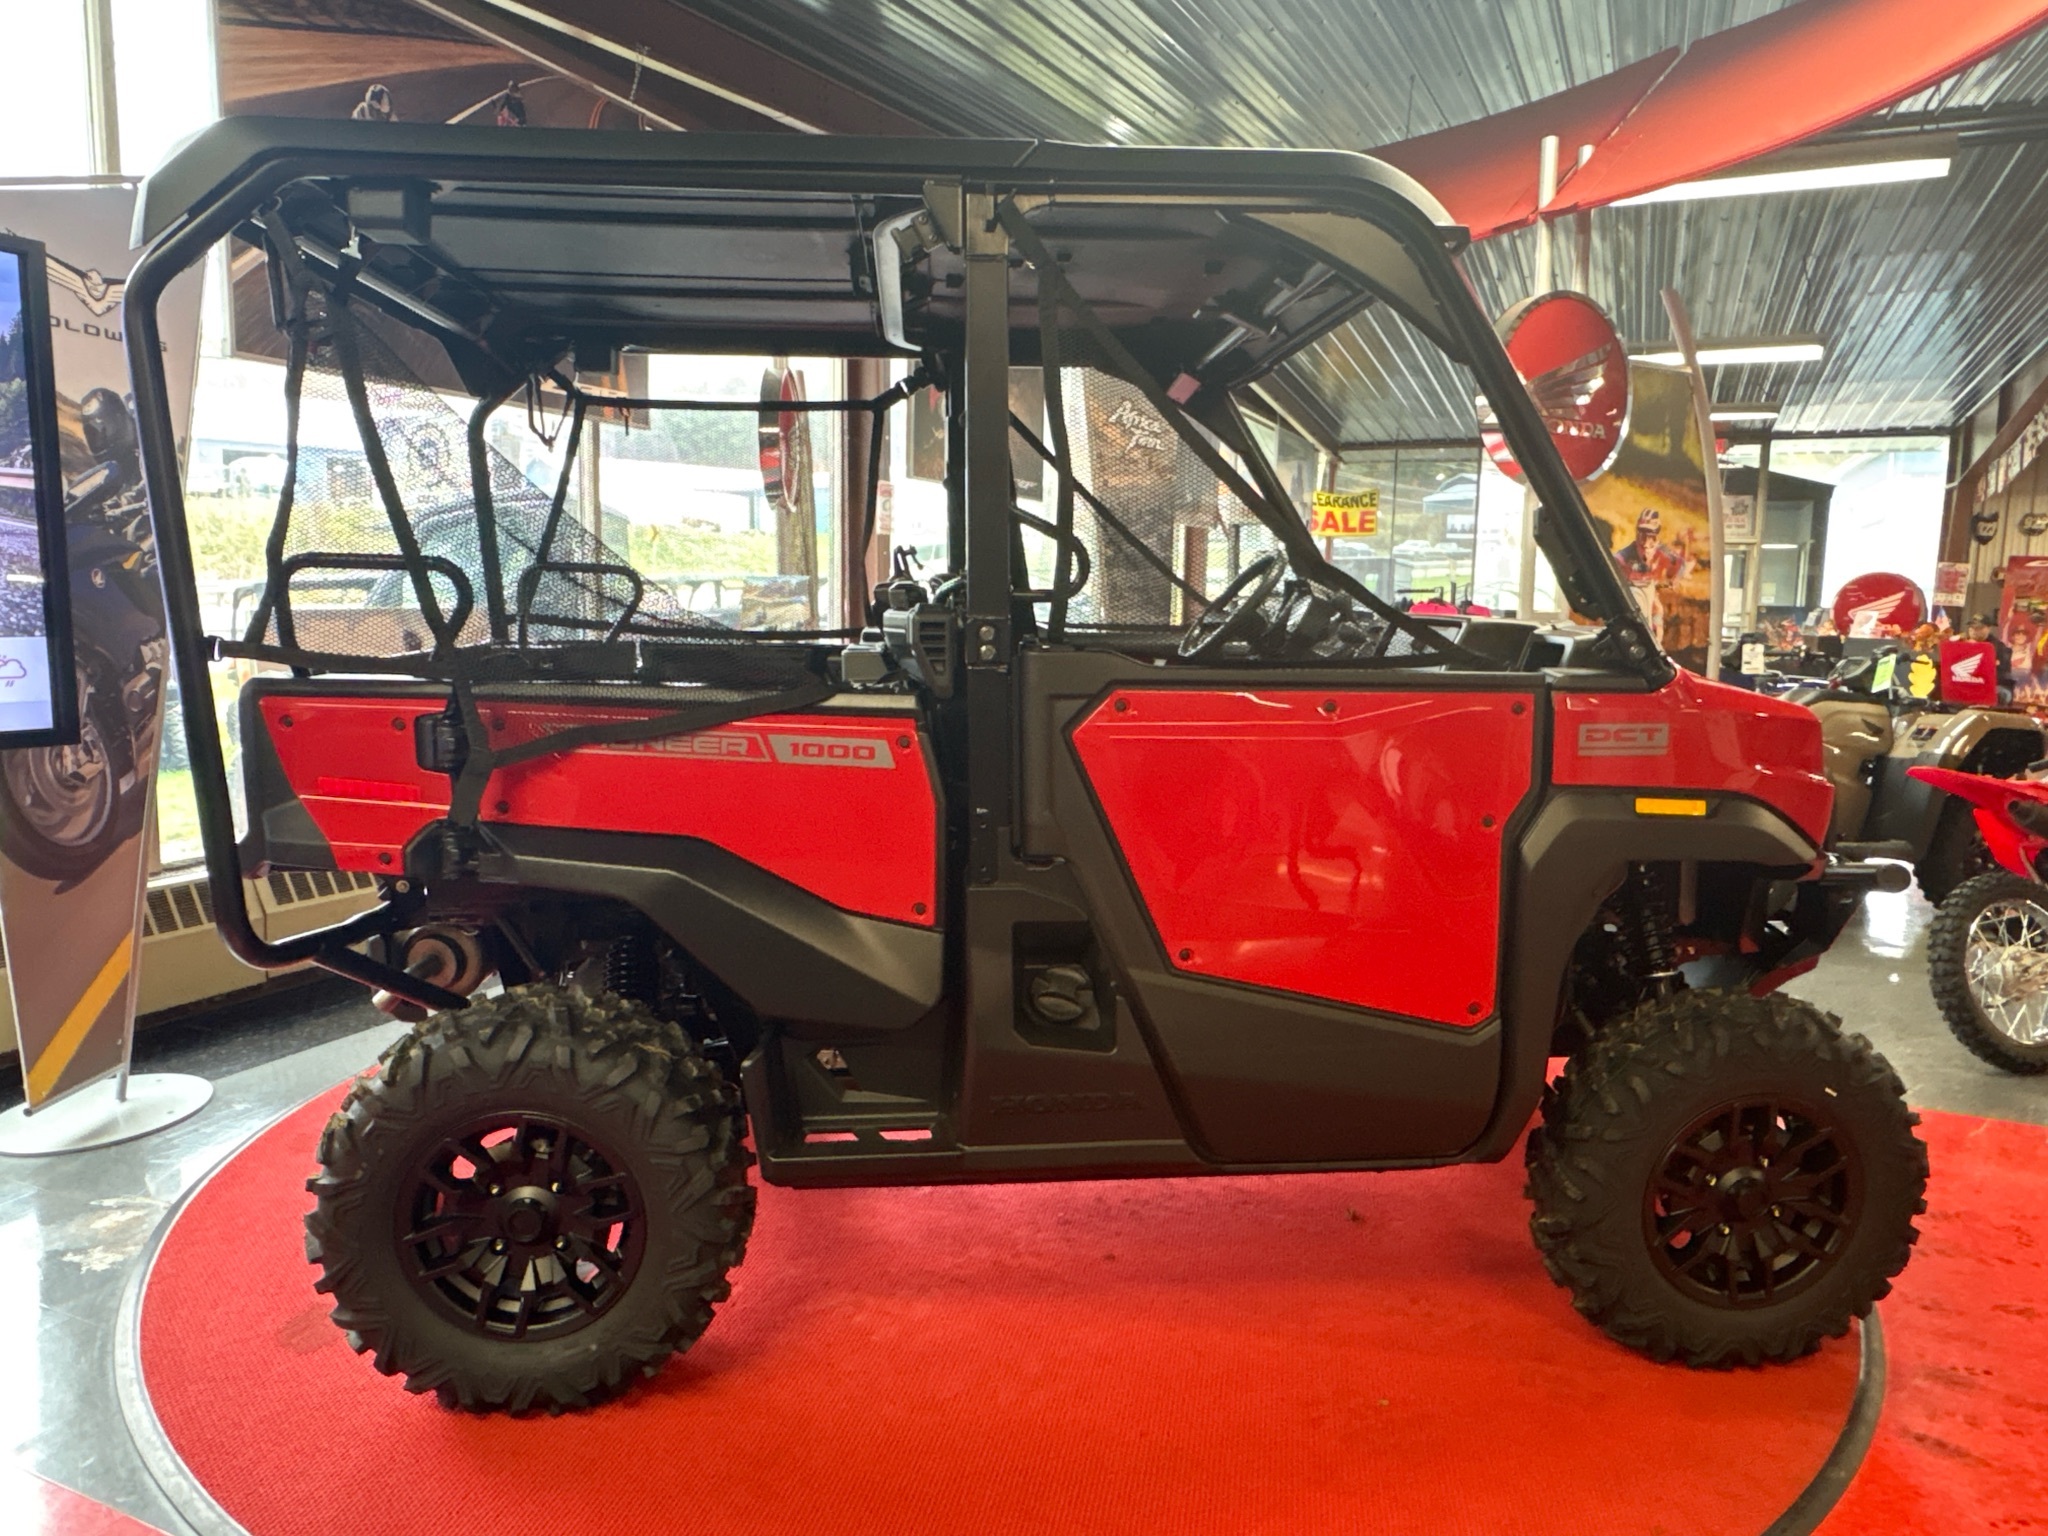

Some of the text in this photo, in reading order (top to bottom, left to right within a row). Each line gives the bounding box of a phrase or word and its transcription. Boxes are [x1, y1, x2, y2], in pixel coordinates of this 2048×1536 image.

[1547, 418, 1607, 439] ONDA
[1585, 727, 1663, 743] DCT
[788, 741, 877, 762] 1000
